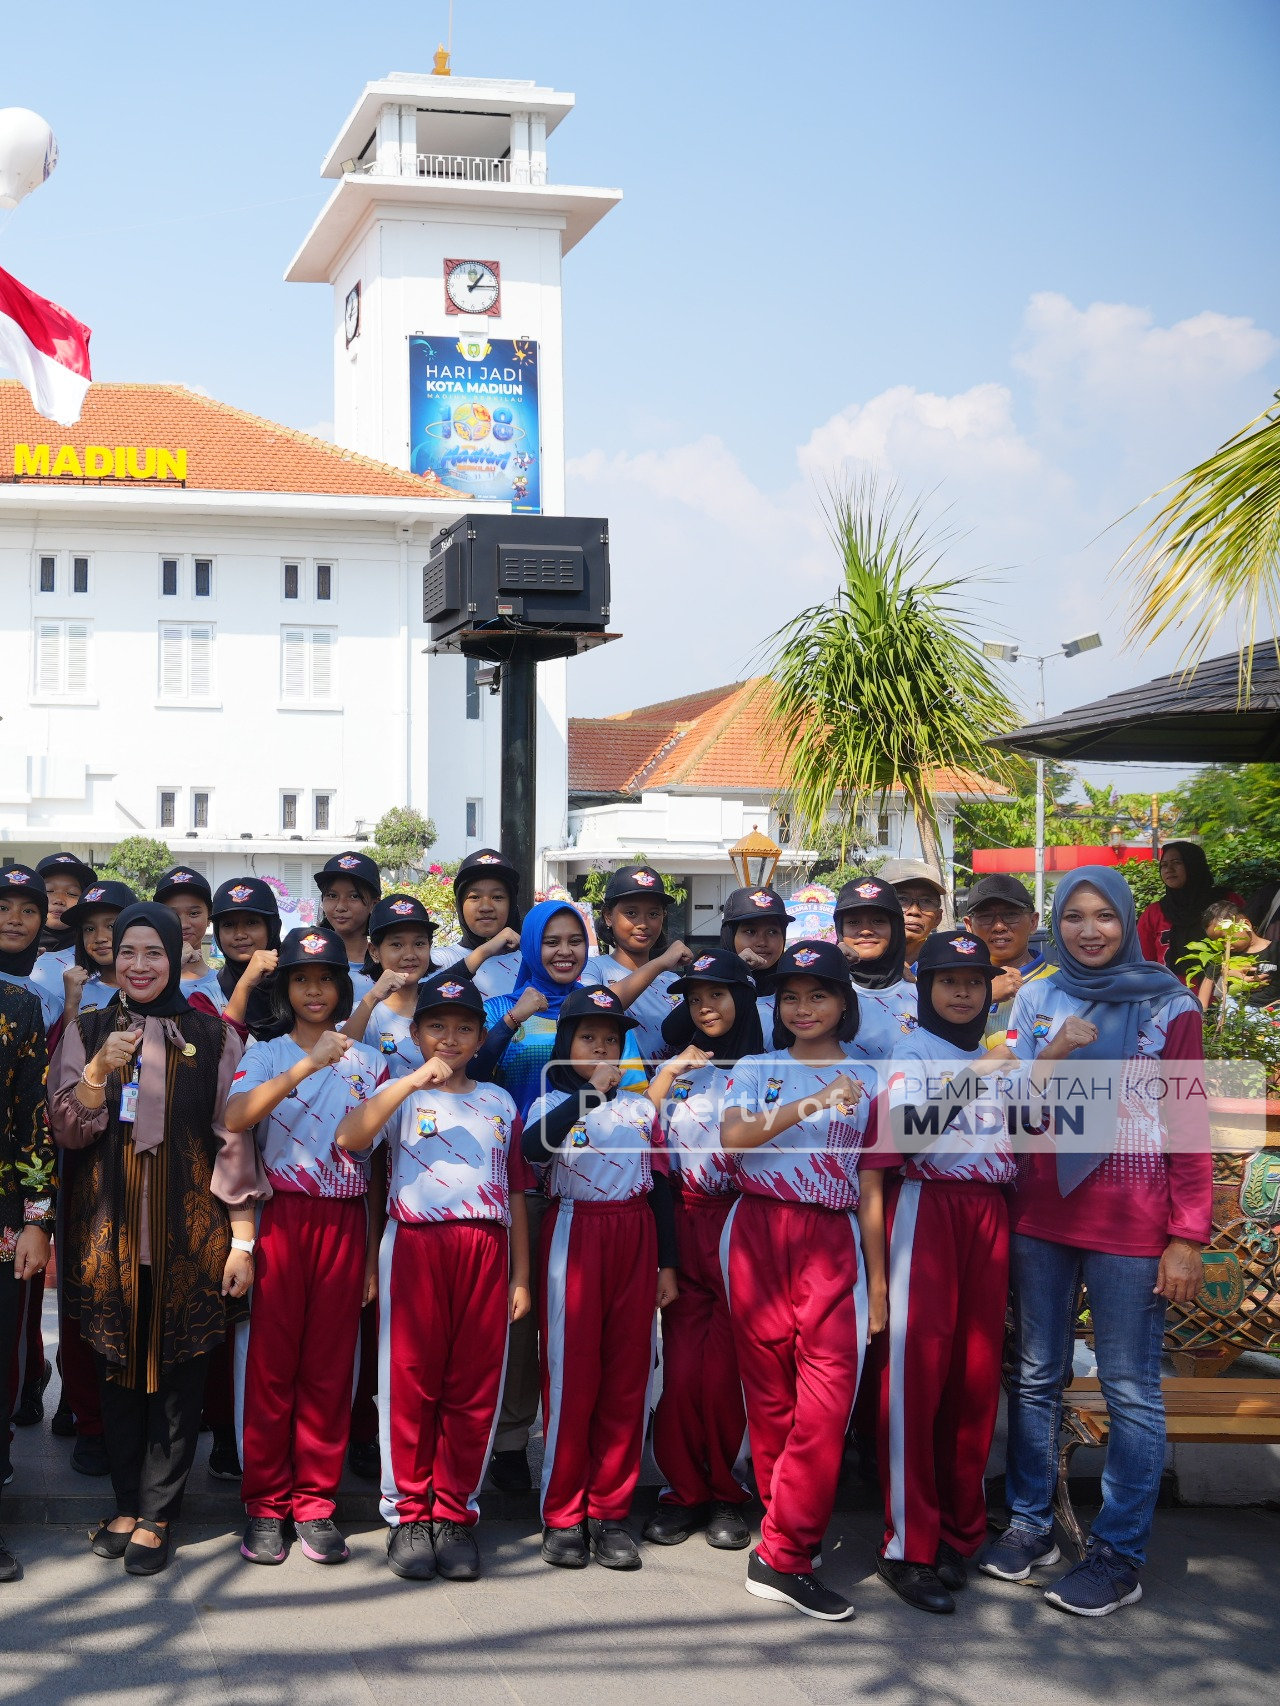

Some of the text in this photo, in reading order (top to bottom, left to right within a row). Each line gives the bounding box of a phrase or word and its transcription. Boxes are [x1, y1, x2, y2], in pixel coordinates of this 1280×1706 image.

[426, 364, 522, 382] HARI JADI
[426, 380, 522, 395] KOTA MADIUN
[14, 443, 188, 480] MADIUN
